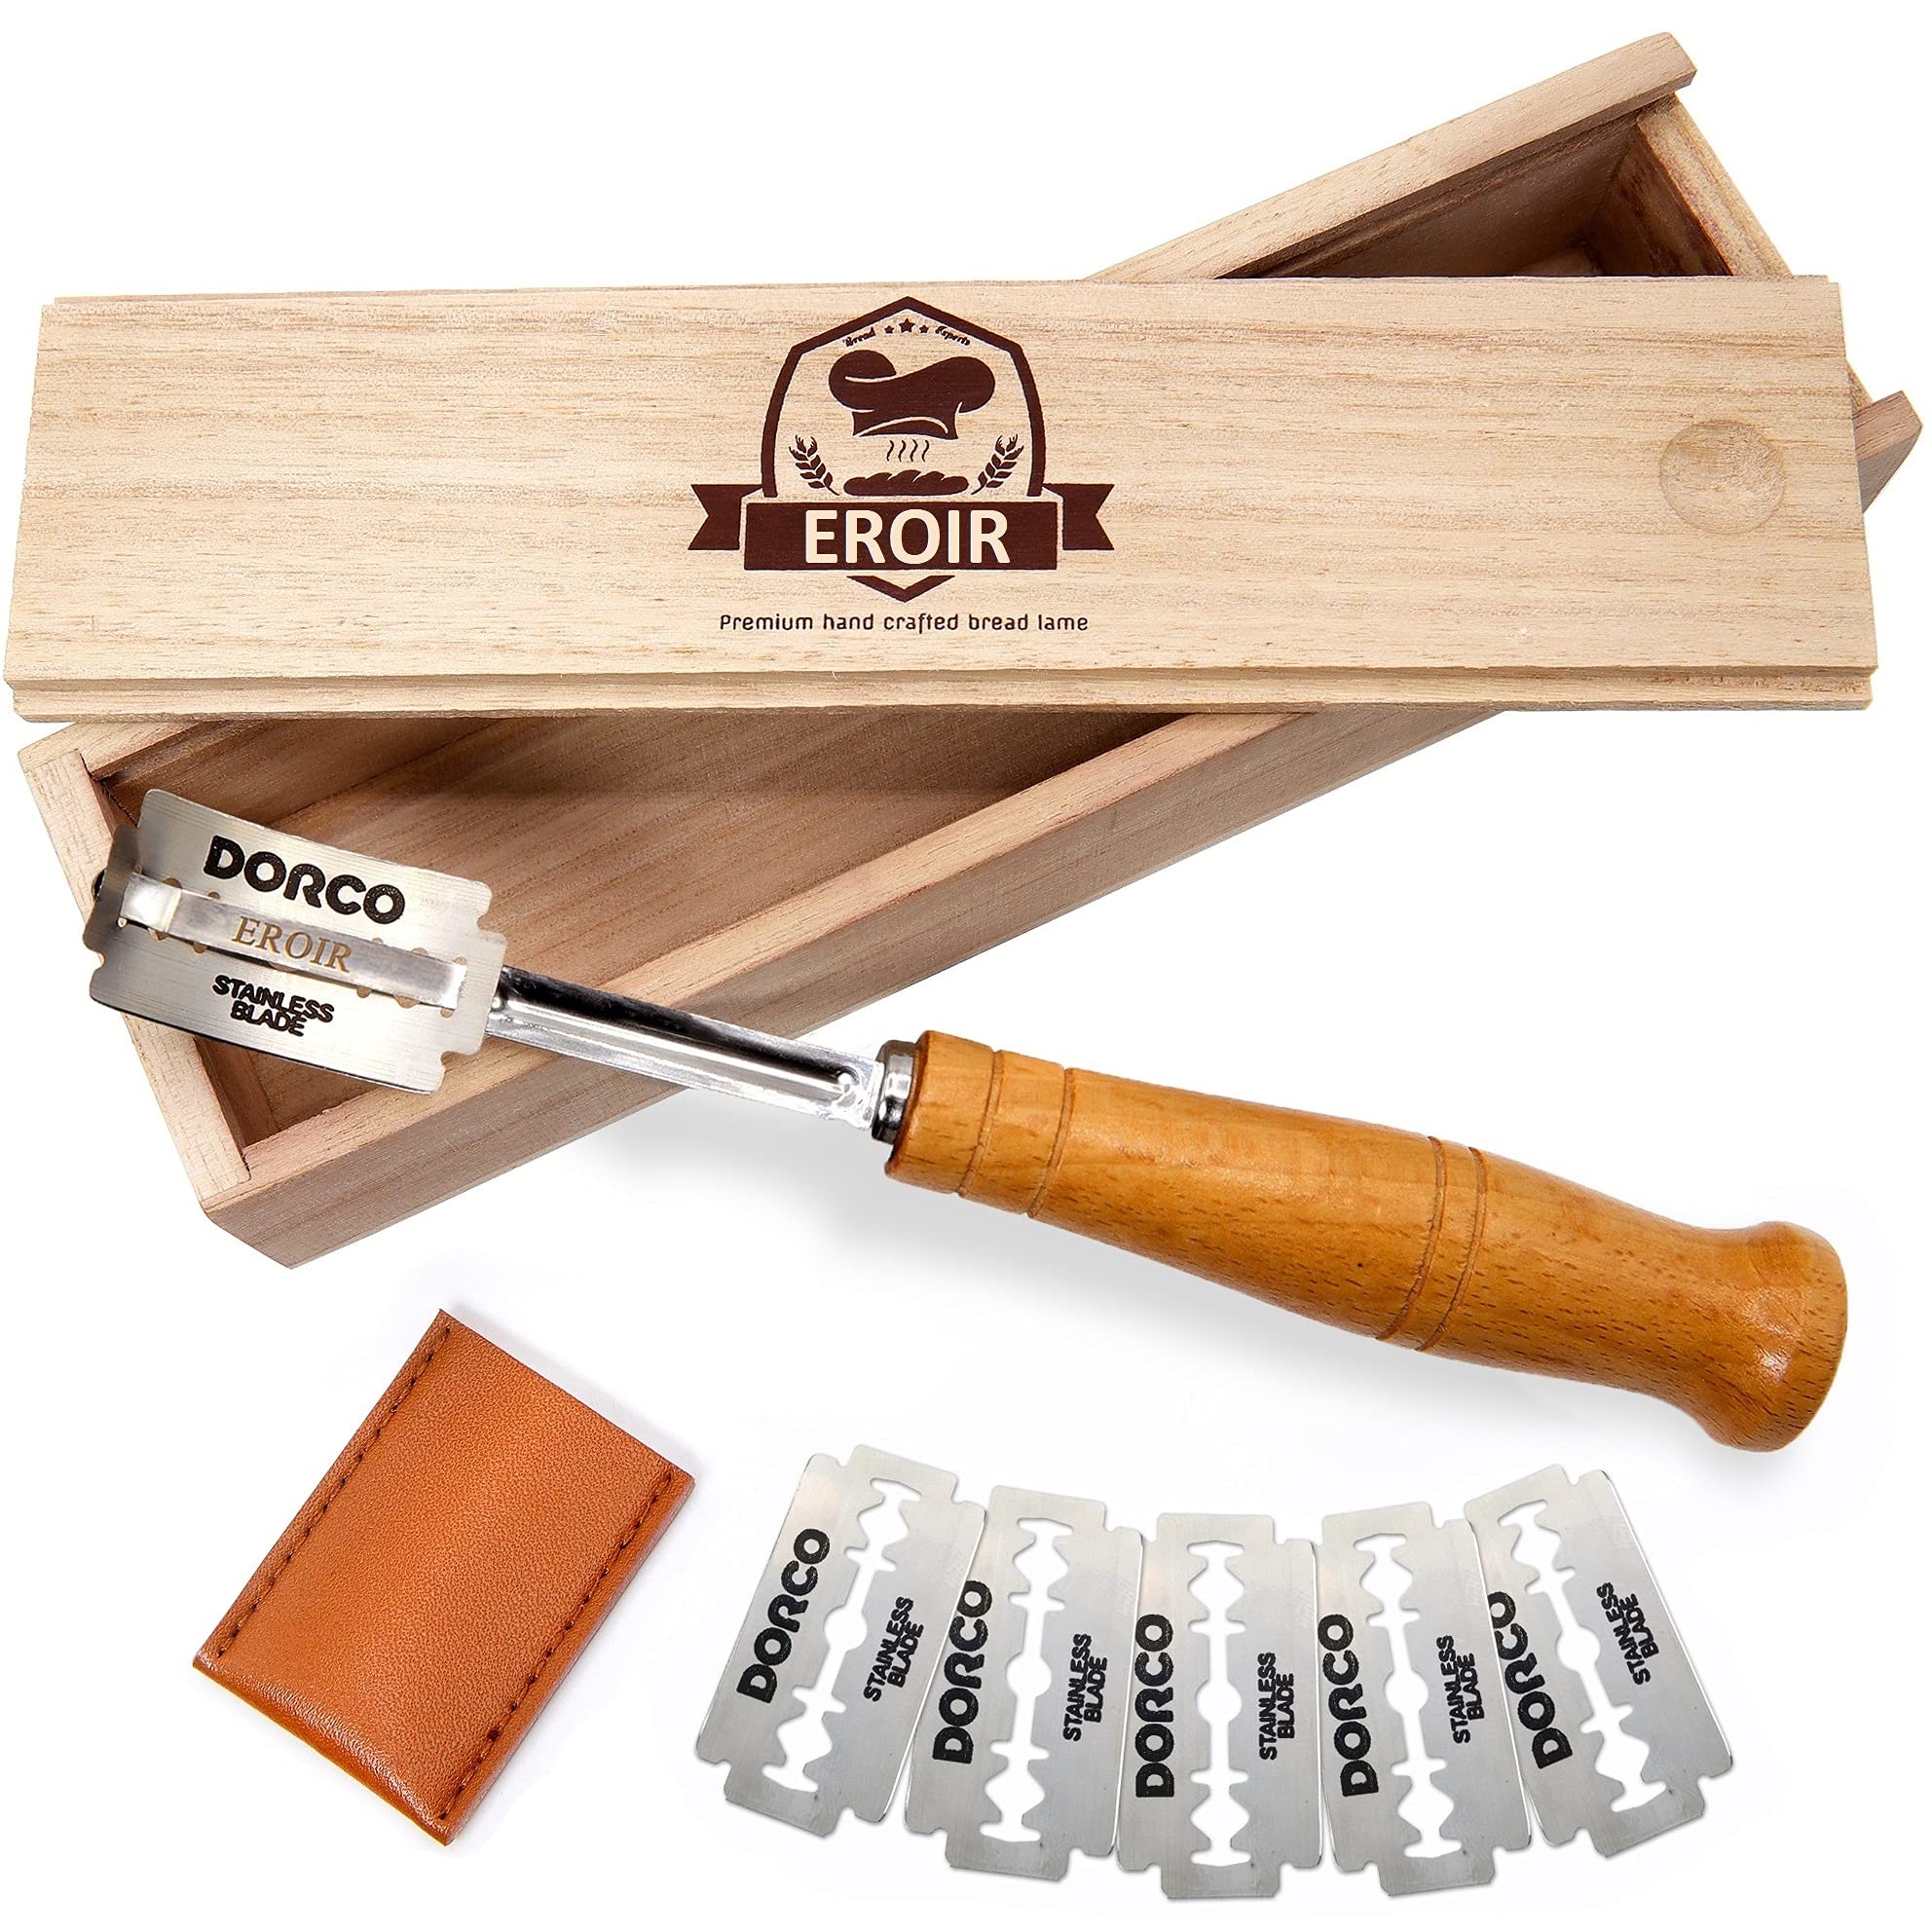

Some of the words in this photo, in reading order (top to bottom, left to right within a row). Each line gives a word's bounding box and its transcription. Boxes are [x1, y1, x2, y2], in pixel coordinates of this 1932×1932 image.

[804, 508, 1012, 566] EROIR
[720, 613, 814, 632] Premium
[823, 613, 874, 632] hand
[883, 613, 960, 635] crafted
[969, 613, 1029, 632] bread
[1038, 613, 1089, 632] lame
[204, 835, 406, 925] DORCO
[232, 915, 353, 973] EROIR
[211, 974, 335, 1023] STAINLESS
[230, 1000, 309, 1037] BLADE
[736, 1528, 831, 1704] DORCO
[863, 1595, 913, 1702] STAINLESS
[887, 1620, 924, 1689] BLADE
[1595, 1581, 1653, 1687] STAINLESS
[1618, 1592, 1660, 1658] BLADE
[932, 1579, 993, 1765] DORCO
[1062, 1633, 1092, 1742] STAINLESS
[1083, 1655, 1108, 1724] BLADE
[1134, 1614, 1175, 1799] DORCO
[1257, 1652, 1278, 1762] STAINLESS
[1276, 1672, 1295, 1740] BLADE
[1318, 1614, 1379, 1798] DORCO
[1435, 1635, 1471, 1744] STAINLESS
[1458, 1653, 1485, 1721] BLADE
[1487, 1590, 1574, 1769] DORCO
